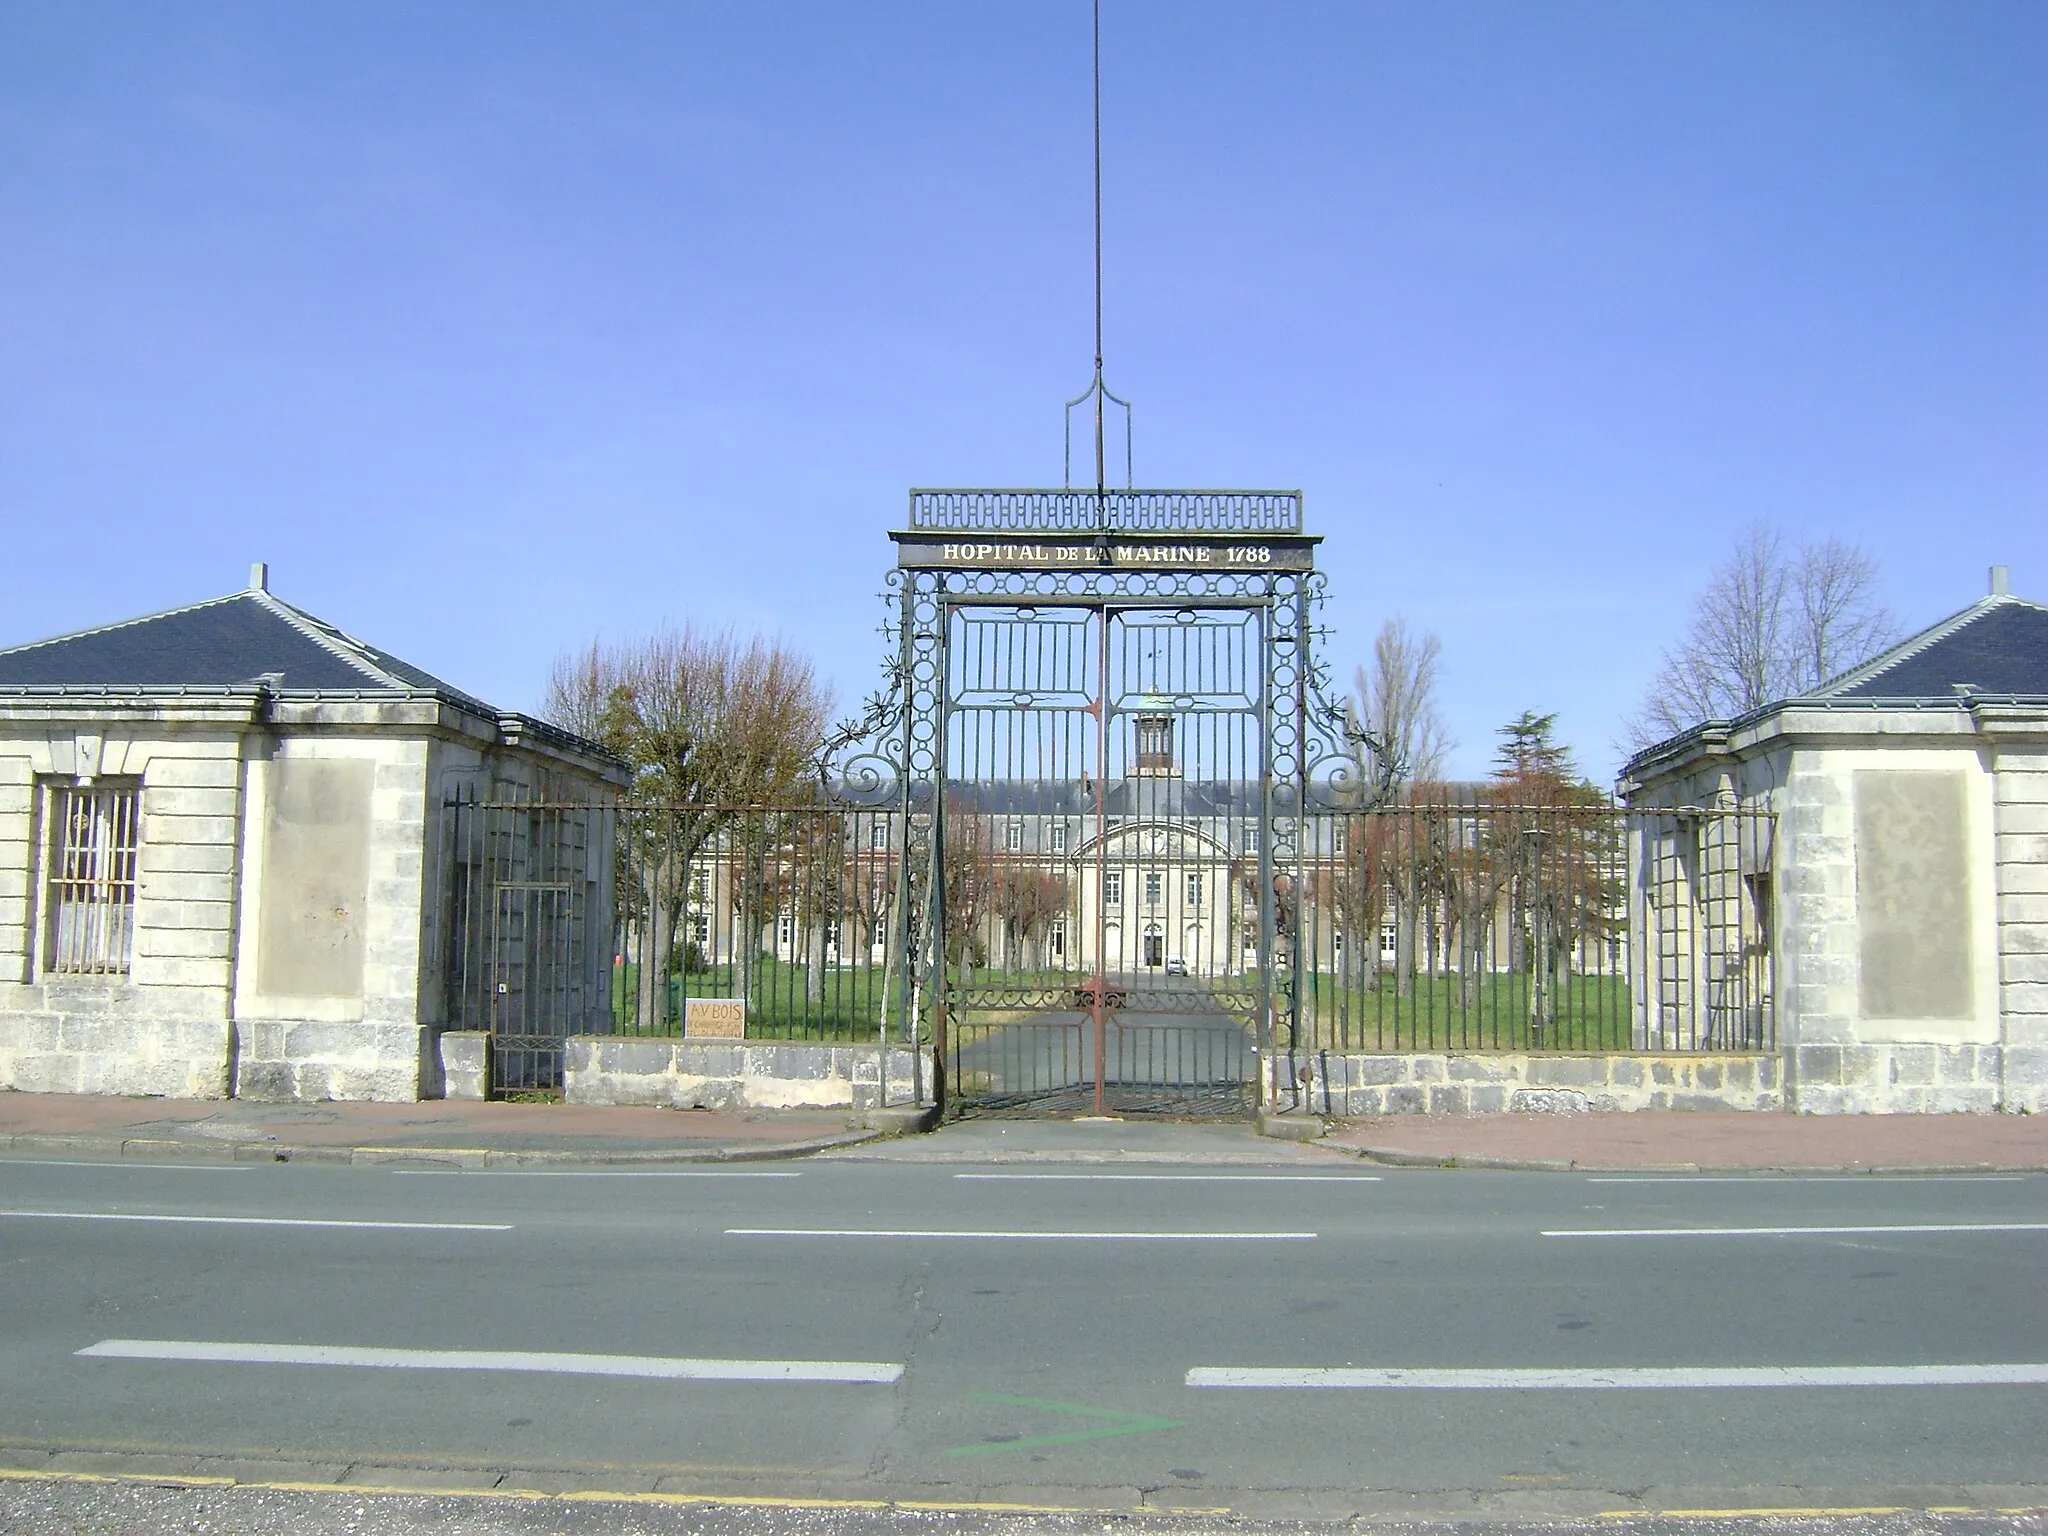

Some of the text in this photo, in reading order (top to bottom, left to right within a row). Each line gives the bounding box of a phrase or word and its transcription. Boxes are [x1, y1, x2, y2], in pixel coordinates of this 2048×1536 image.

[943, 544, 1271, 563] HOPITAL DE LA MARINE 1788
[712, 1002, 741, 1020] BOIS
